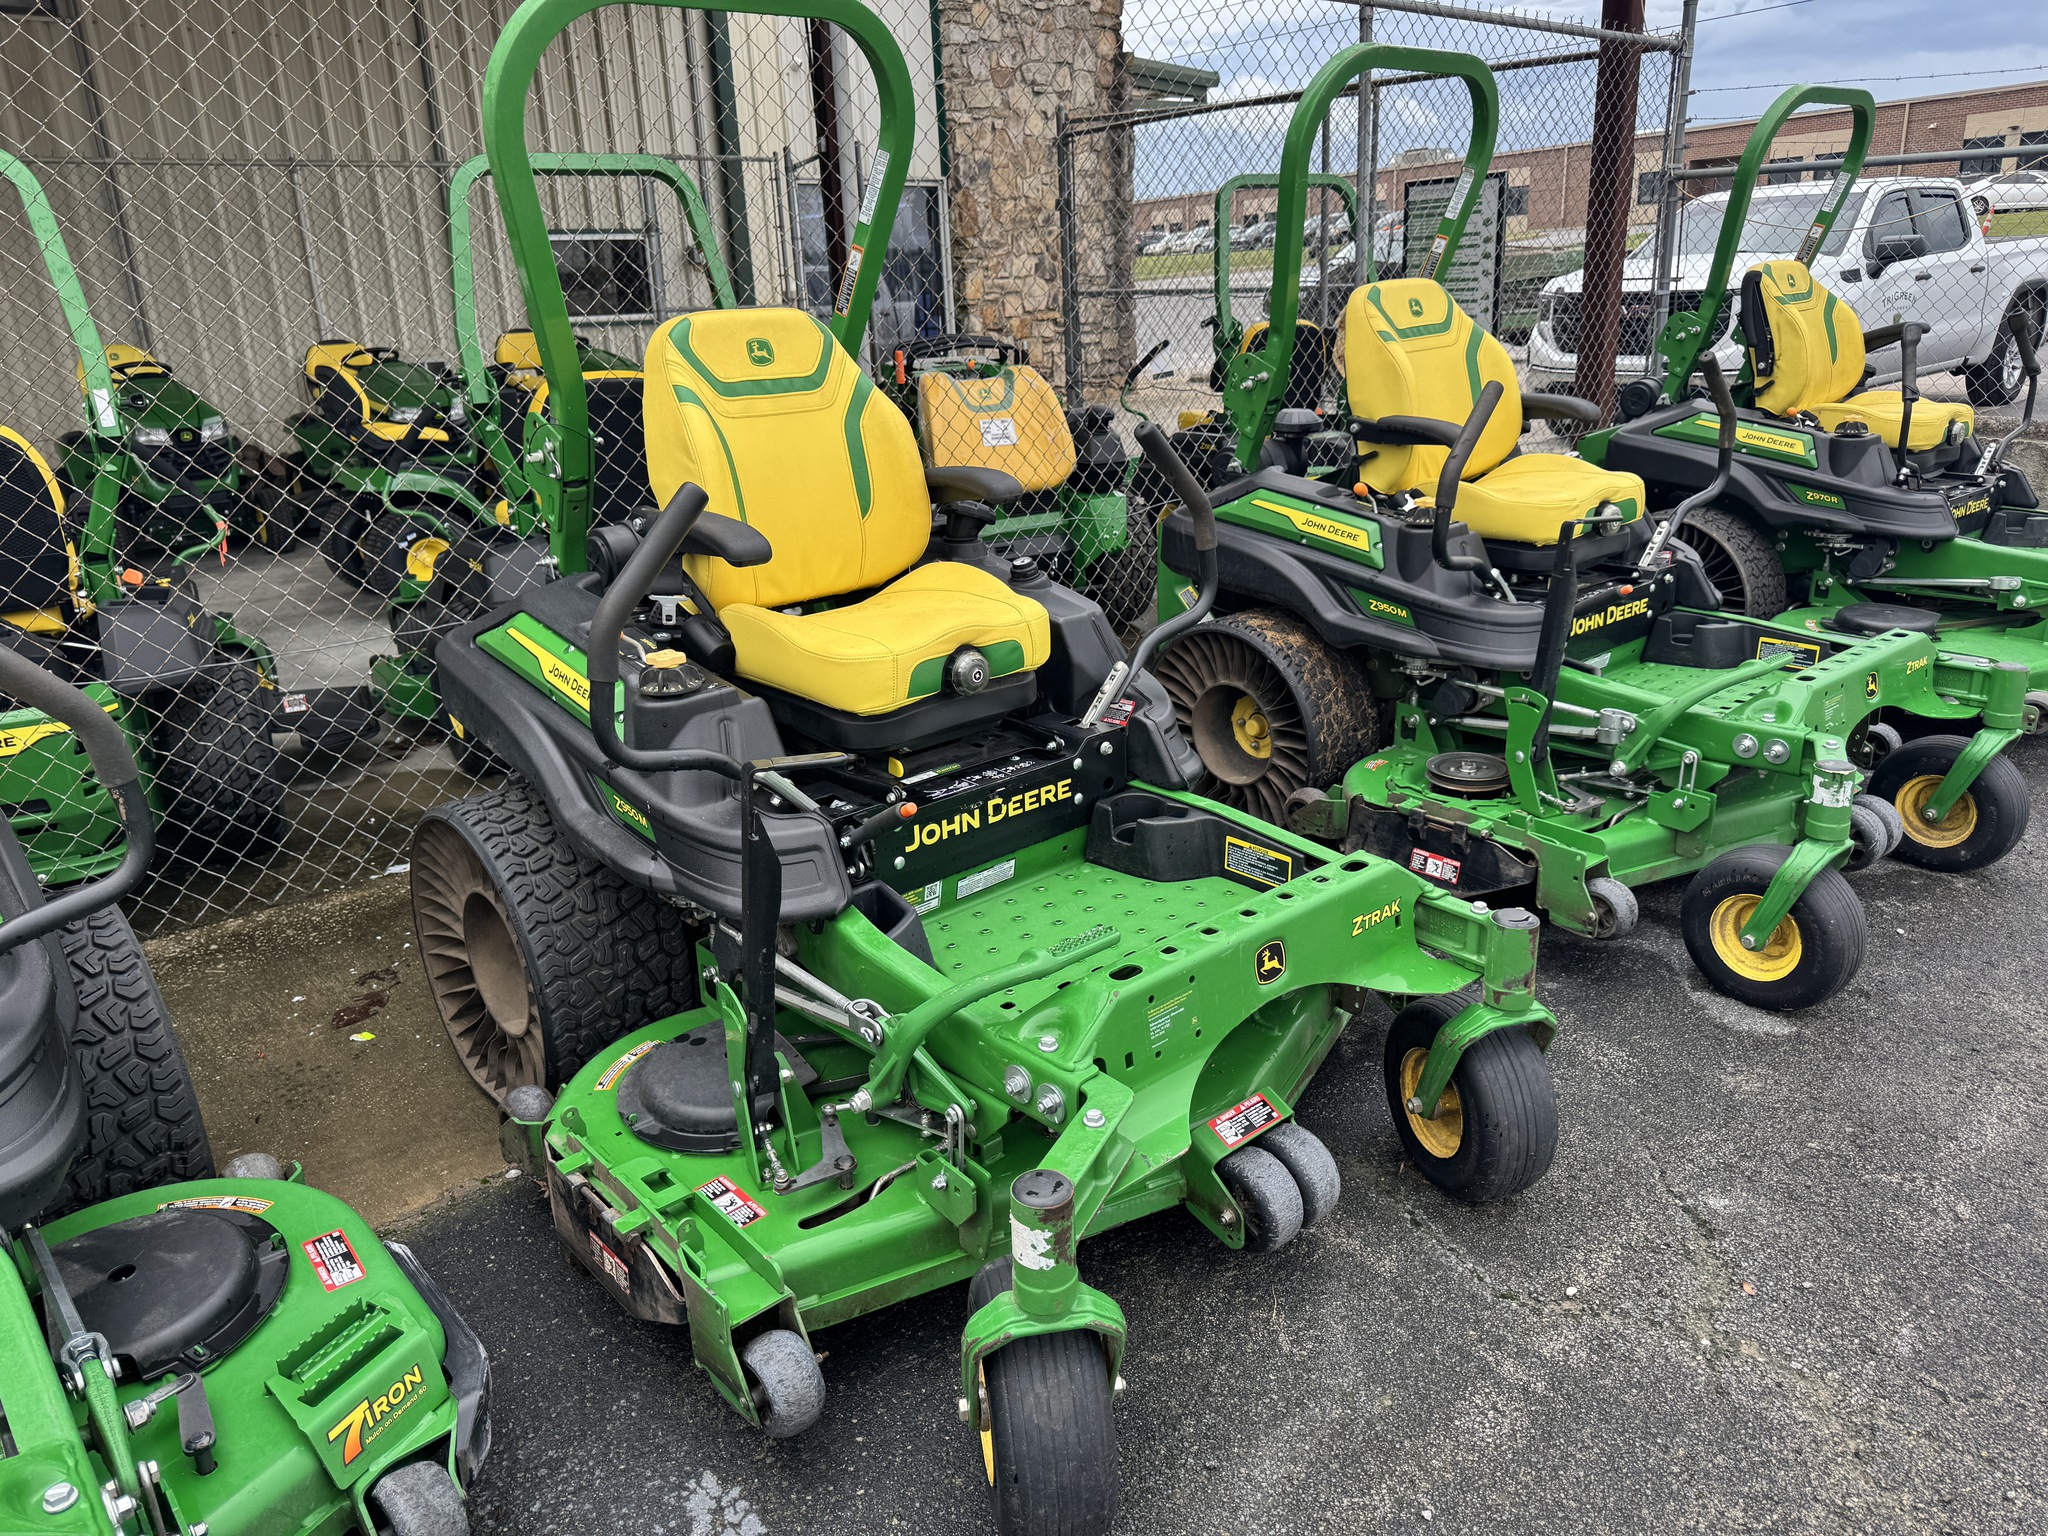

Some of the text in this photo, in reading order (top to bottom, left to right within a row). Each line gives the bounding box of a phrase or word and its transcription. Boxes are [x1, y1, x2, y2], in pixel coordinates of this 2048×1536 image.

[1742, 432, 1796, 449] JOHN DEERE
[1806, 491, 1838, 504] Z970R
[1966, 497, 1989, 516] DEERE
[1301, 517, 1360, 542] JOHN DEERE
[1369, 599, 1407, 618] Z950M
[1570, 598, 1649, 637] JOHN DEERE
[548, 663, 571, 686] JOHN
[1906, 655, 1928, 675] ZTRAK
[613, 794, 648, 829] Z950M
[905, 778, 1072, 853] JOHN DEERE
[1352, 897, 1402, 938] ZTRAK
[365, 1385, 427, 1445] Mulch on Demand 60
